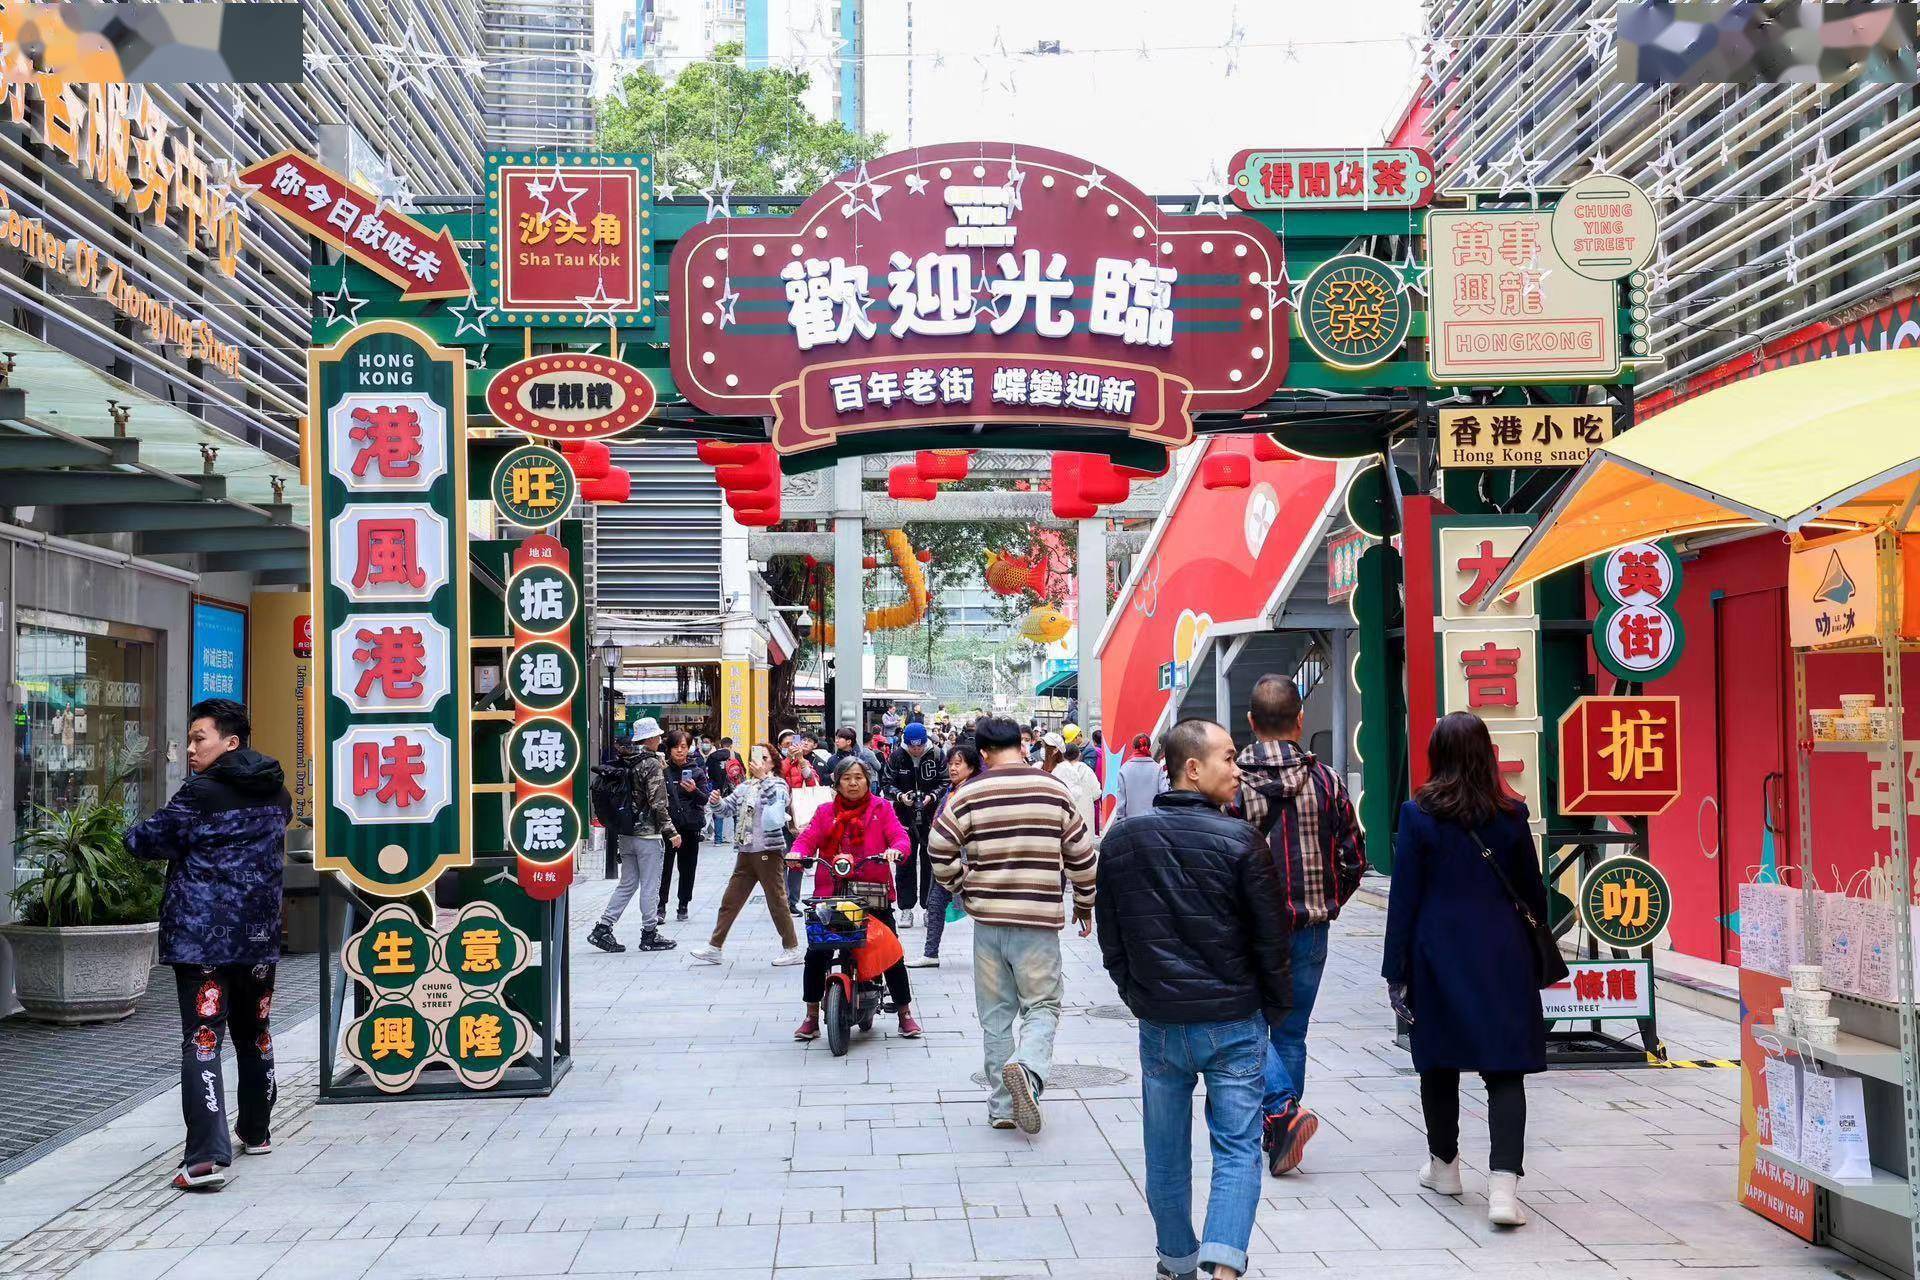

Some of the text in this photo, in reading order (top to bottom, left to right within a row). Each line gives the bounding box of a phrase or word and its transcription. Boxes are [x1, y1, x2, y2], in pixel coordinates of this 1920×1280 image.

[270, 162, 443, 284] 你今日飲咗未
[1573, 203, 1633, 218] CHUNG
[519, 212, 621, 246] 沙头角
[1451, 221, 1541, 266] 萬事
[1573, 236, 1636, 252] STREET
[1583, 221, 1625, 236] YING
[520, 252, 621, 266] Sha Tau Kok
[76, 239, 98, 293] Of
[106, 258, 192, 359] Zhongying
[199, 319, 239, 380] Street
[780, 248, 1179, 351] 歡迎光臨
[1324, 279, 1386, 342] 發
[1455, 330, 1593, 354] HONGKONG
[358, 354, 415, 368] HONG
[358, 371, 415, 386] KONG
[828, 366, 1137, 415] 百年老街 蝶變迎新
[529, 382, 613, 410] 便靚讚
[1450, 413, 1604, 447] 香港小吃
[1453, 449, 1495, 464] Hong
[1502, 449, 1543, 464] Kong
[512, 466, 557, 508] 旺
[528, 547, 553, 559] 地道
[348, 405, 427, 808] 港風港味
[1617, 552, 1663, 659] 英街
[1598, 709, 1667, 782] 掂
[532, 870, 557, 883] 传统
[1602, 877, 1649, 928] 叻
[371, 929, 503, 976] 生意
[422, 983, 452, 992] CHUNG
[426, 992, 448, 1000] YING
[422, 1001, 452, 1009] STREET
[1545, 1004, 1601, 1013] YING STREET
[371, 1014, 503, 1061] 興隆
[1744, 1182, 1806, 1225] HAPPY NEW YEAR
